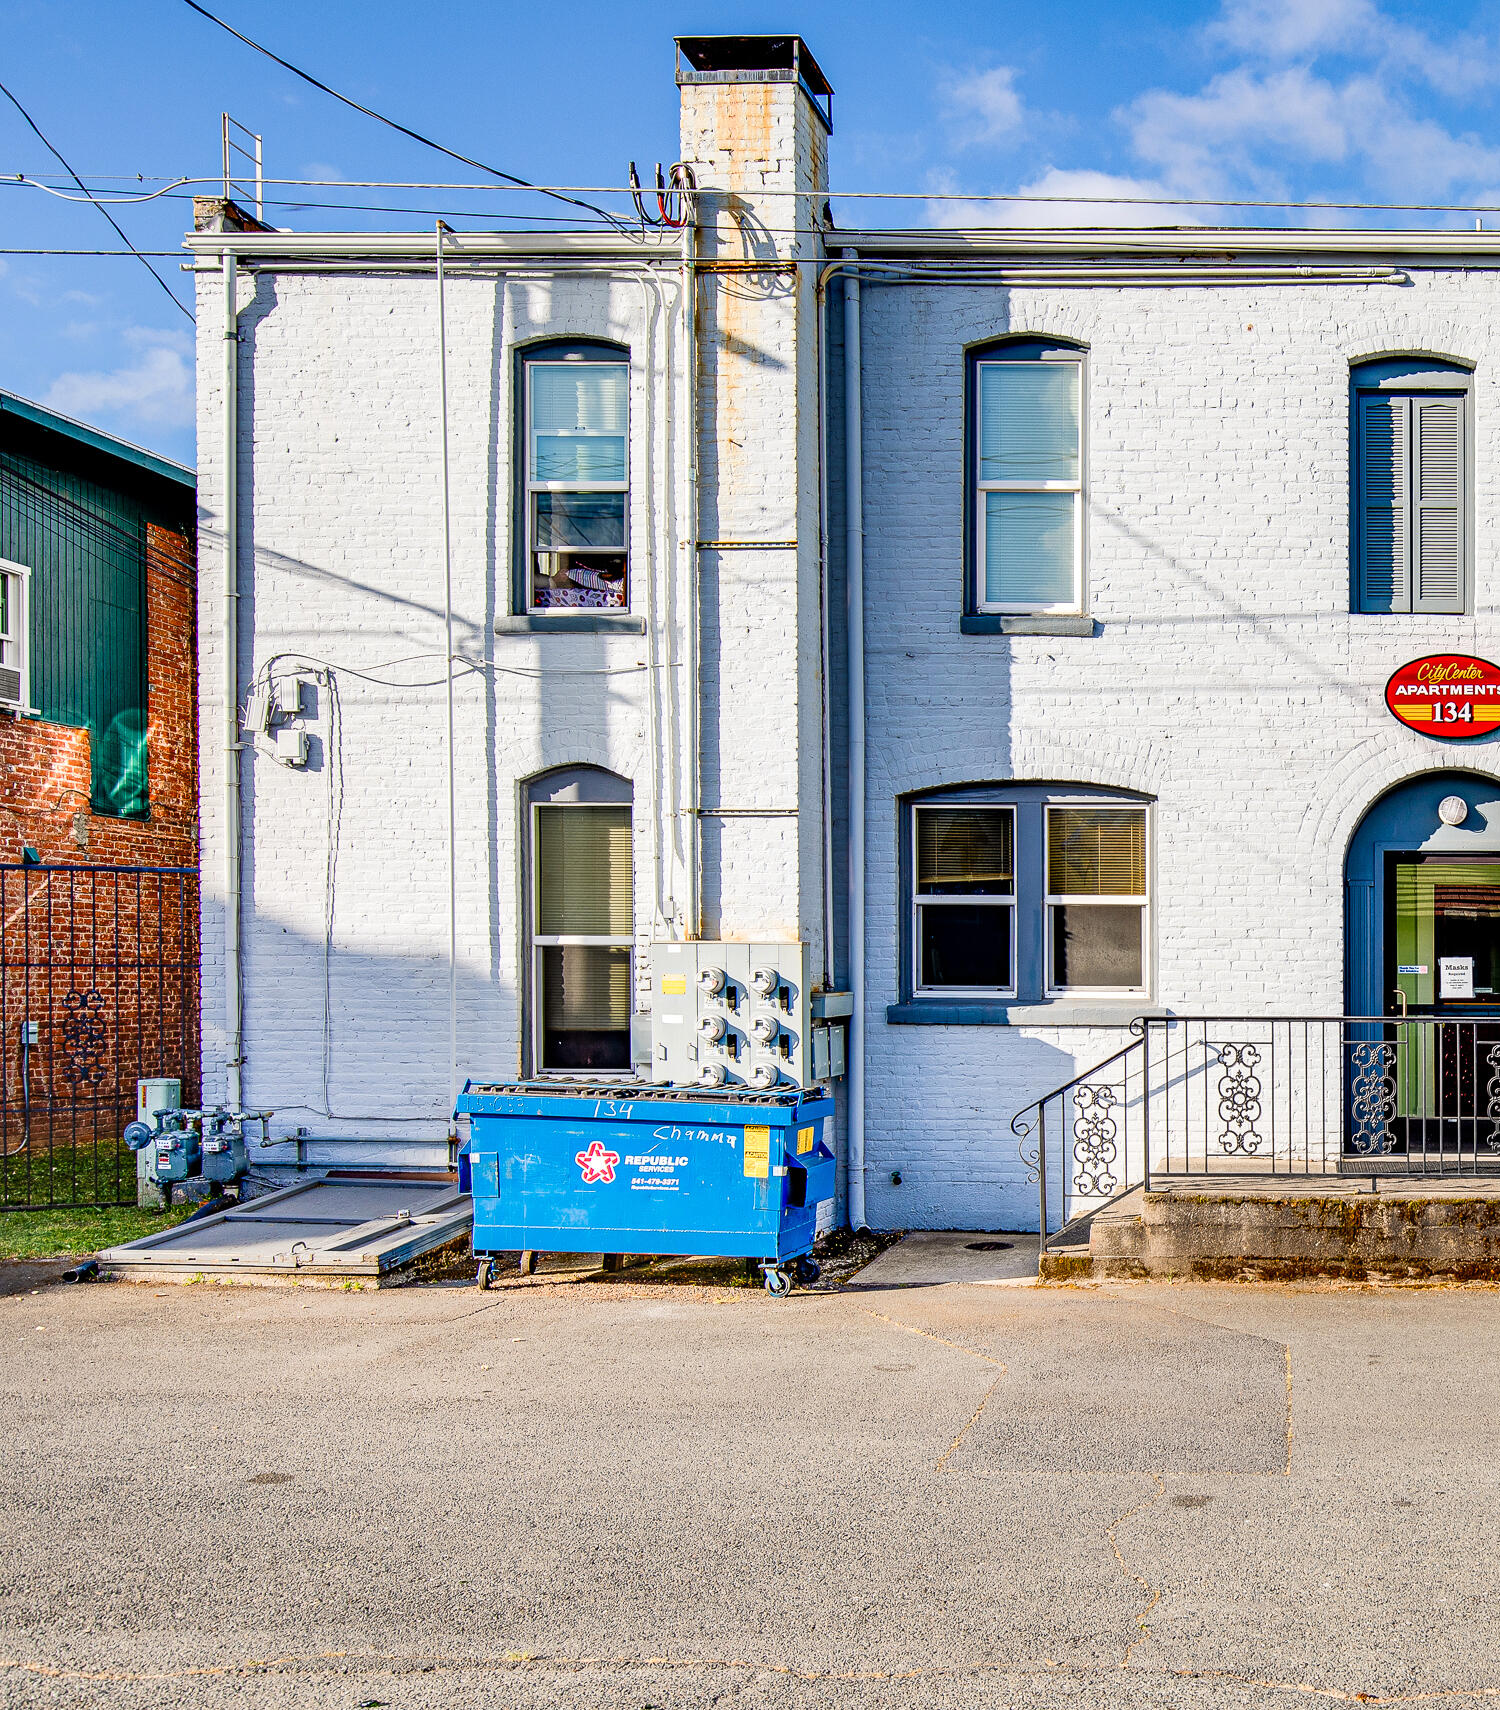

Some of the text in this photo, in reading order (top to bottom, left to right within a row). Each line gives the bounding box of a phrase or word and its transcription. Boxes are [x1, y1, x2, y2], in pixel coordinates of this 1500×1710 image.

[1432, 701, 1473, 723] 134
[593, 1100, 634, 1120] 134
[625, 1155, 689, 1166] REPUBLIC
[638, 1165, 675, 1173] SERVICES
